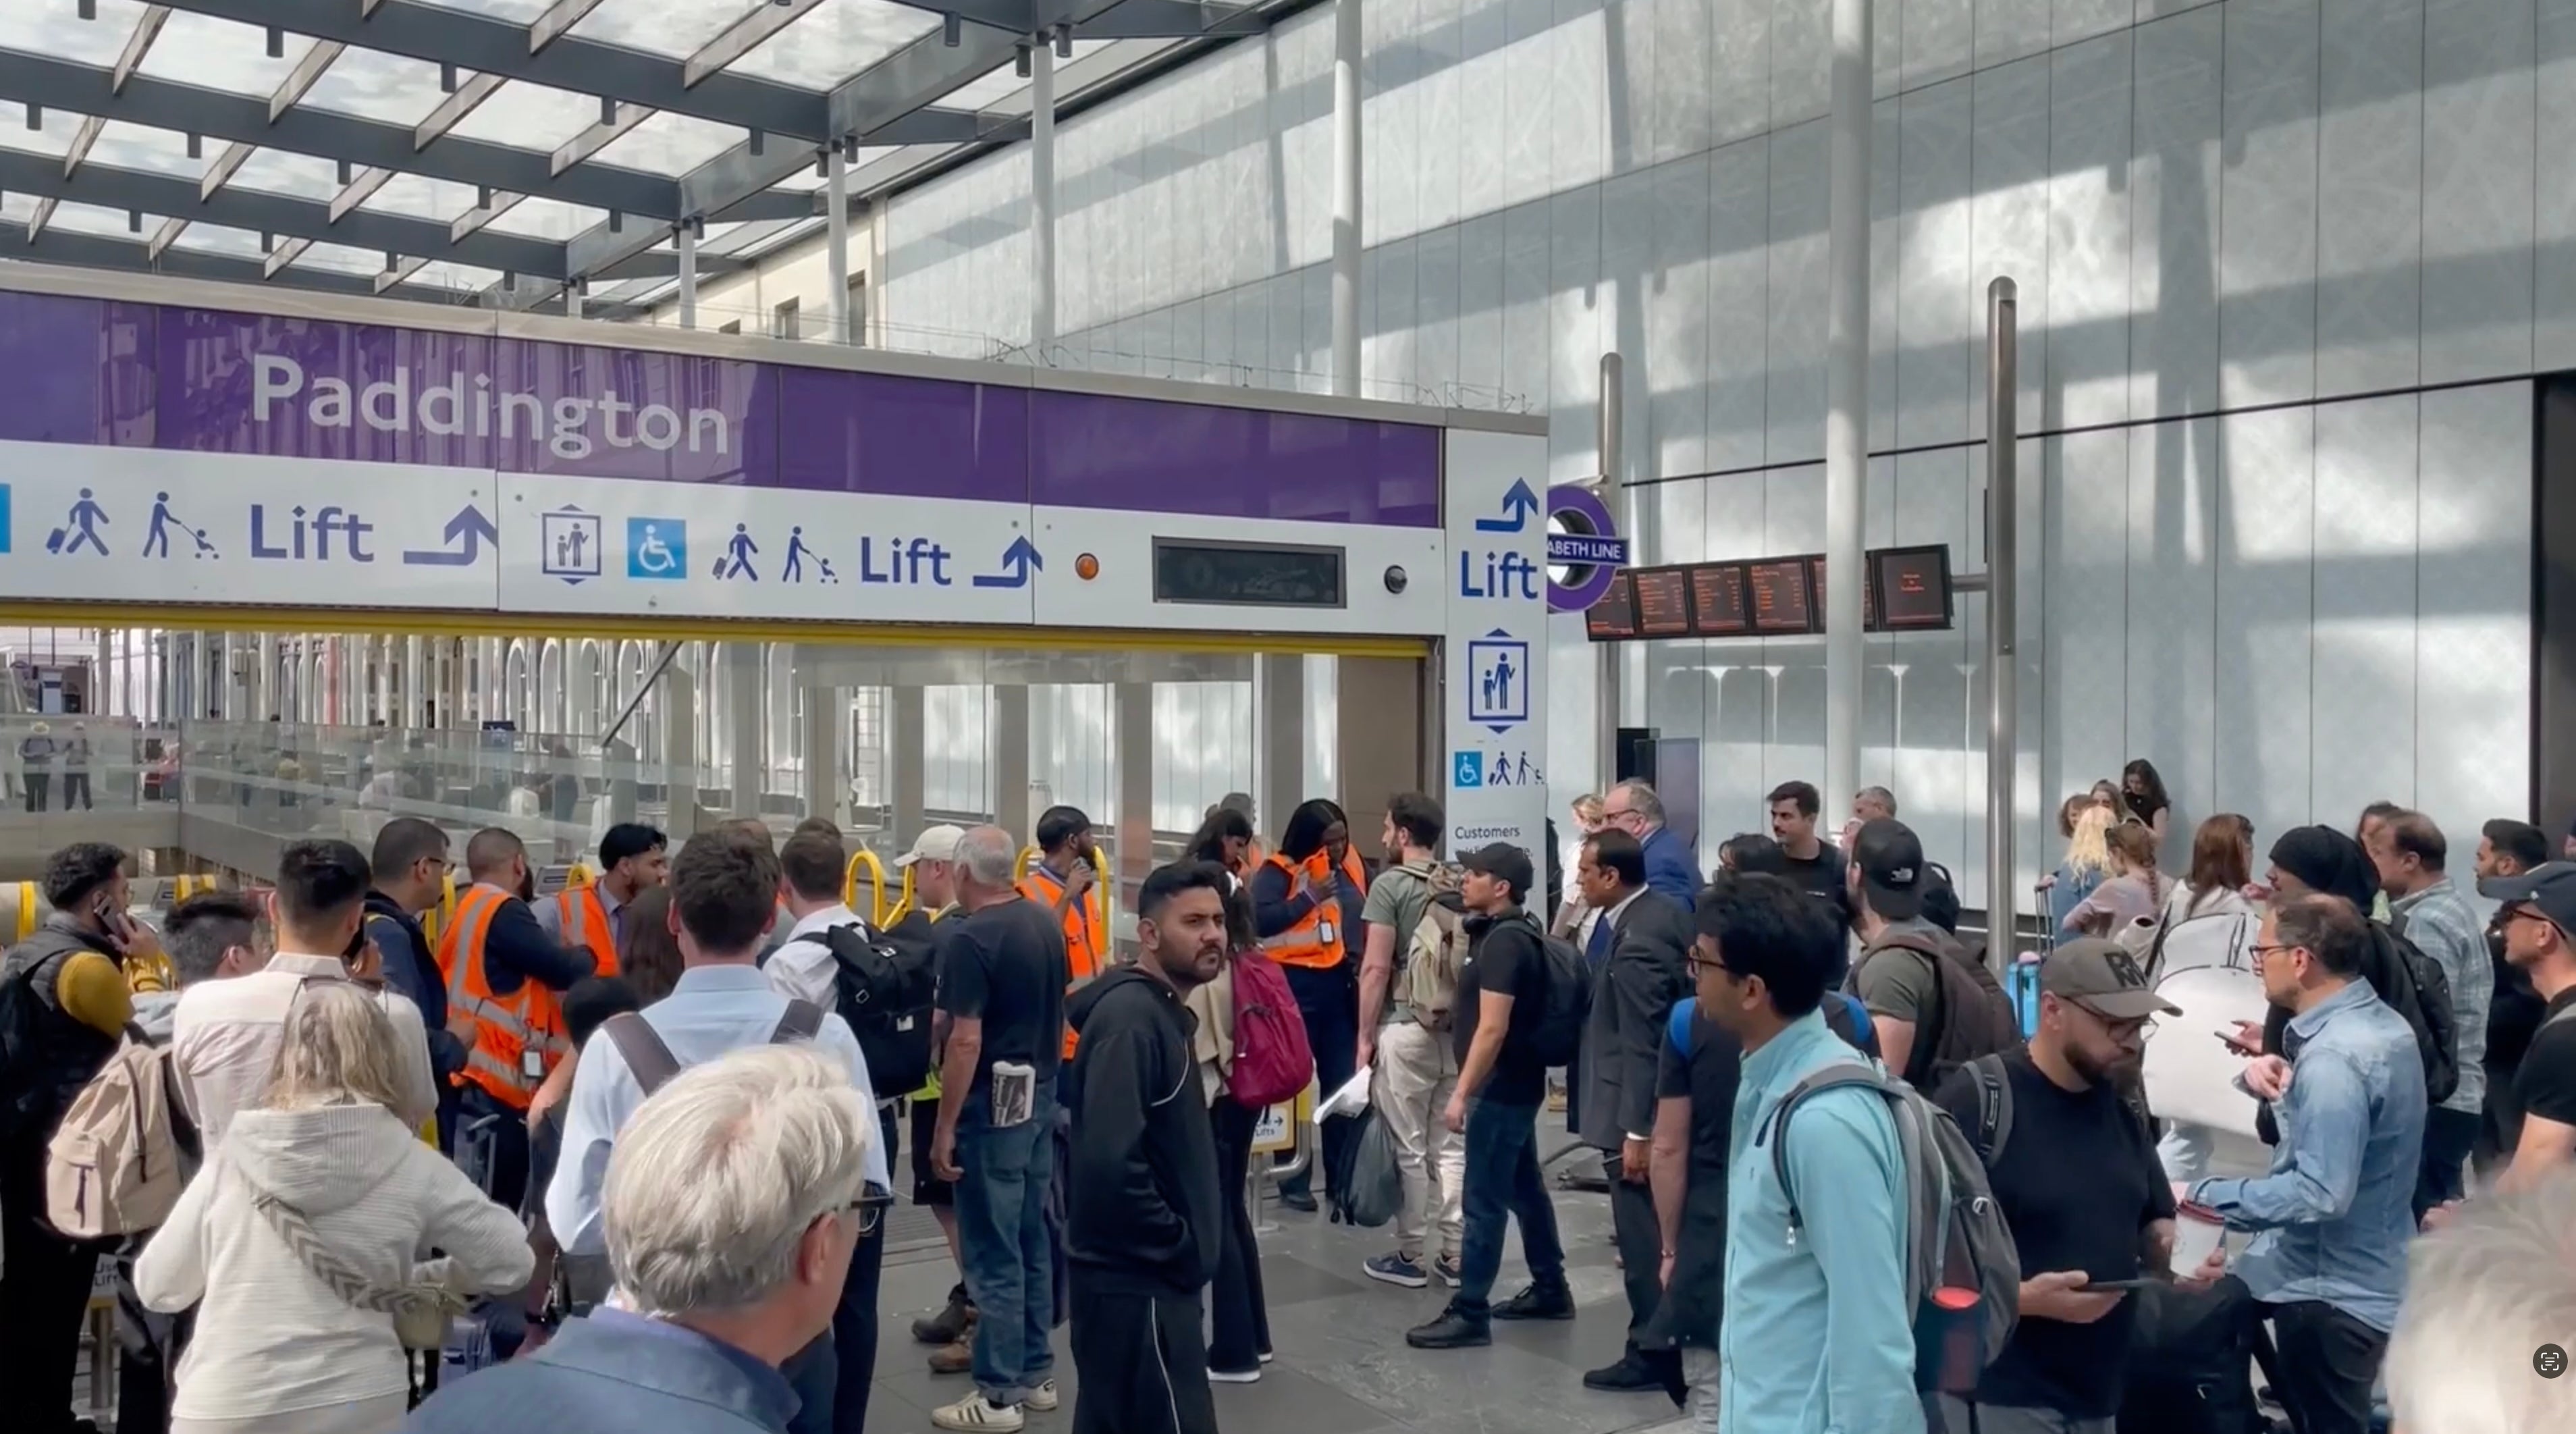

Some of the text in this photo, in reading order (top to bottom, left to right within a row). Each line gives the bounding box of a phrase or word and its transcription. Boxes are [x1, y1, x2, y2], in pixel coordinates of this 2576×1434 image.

[254, 354, 728, 460] Paddington
[250, 504, 375, 561] Lift
[1548, 541, 1621, 559] ABETH LINE
[861, 537, 952, 586] Lift
[1460, 550, 1538, 600] Lift
[1455, 826, 1521, 839] Customers
